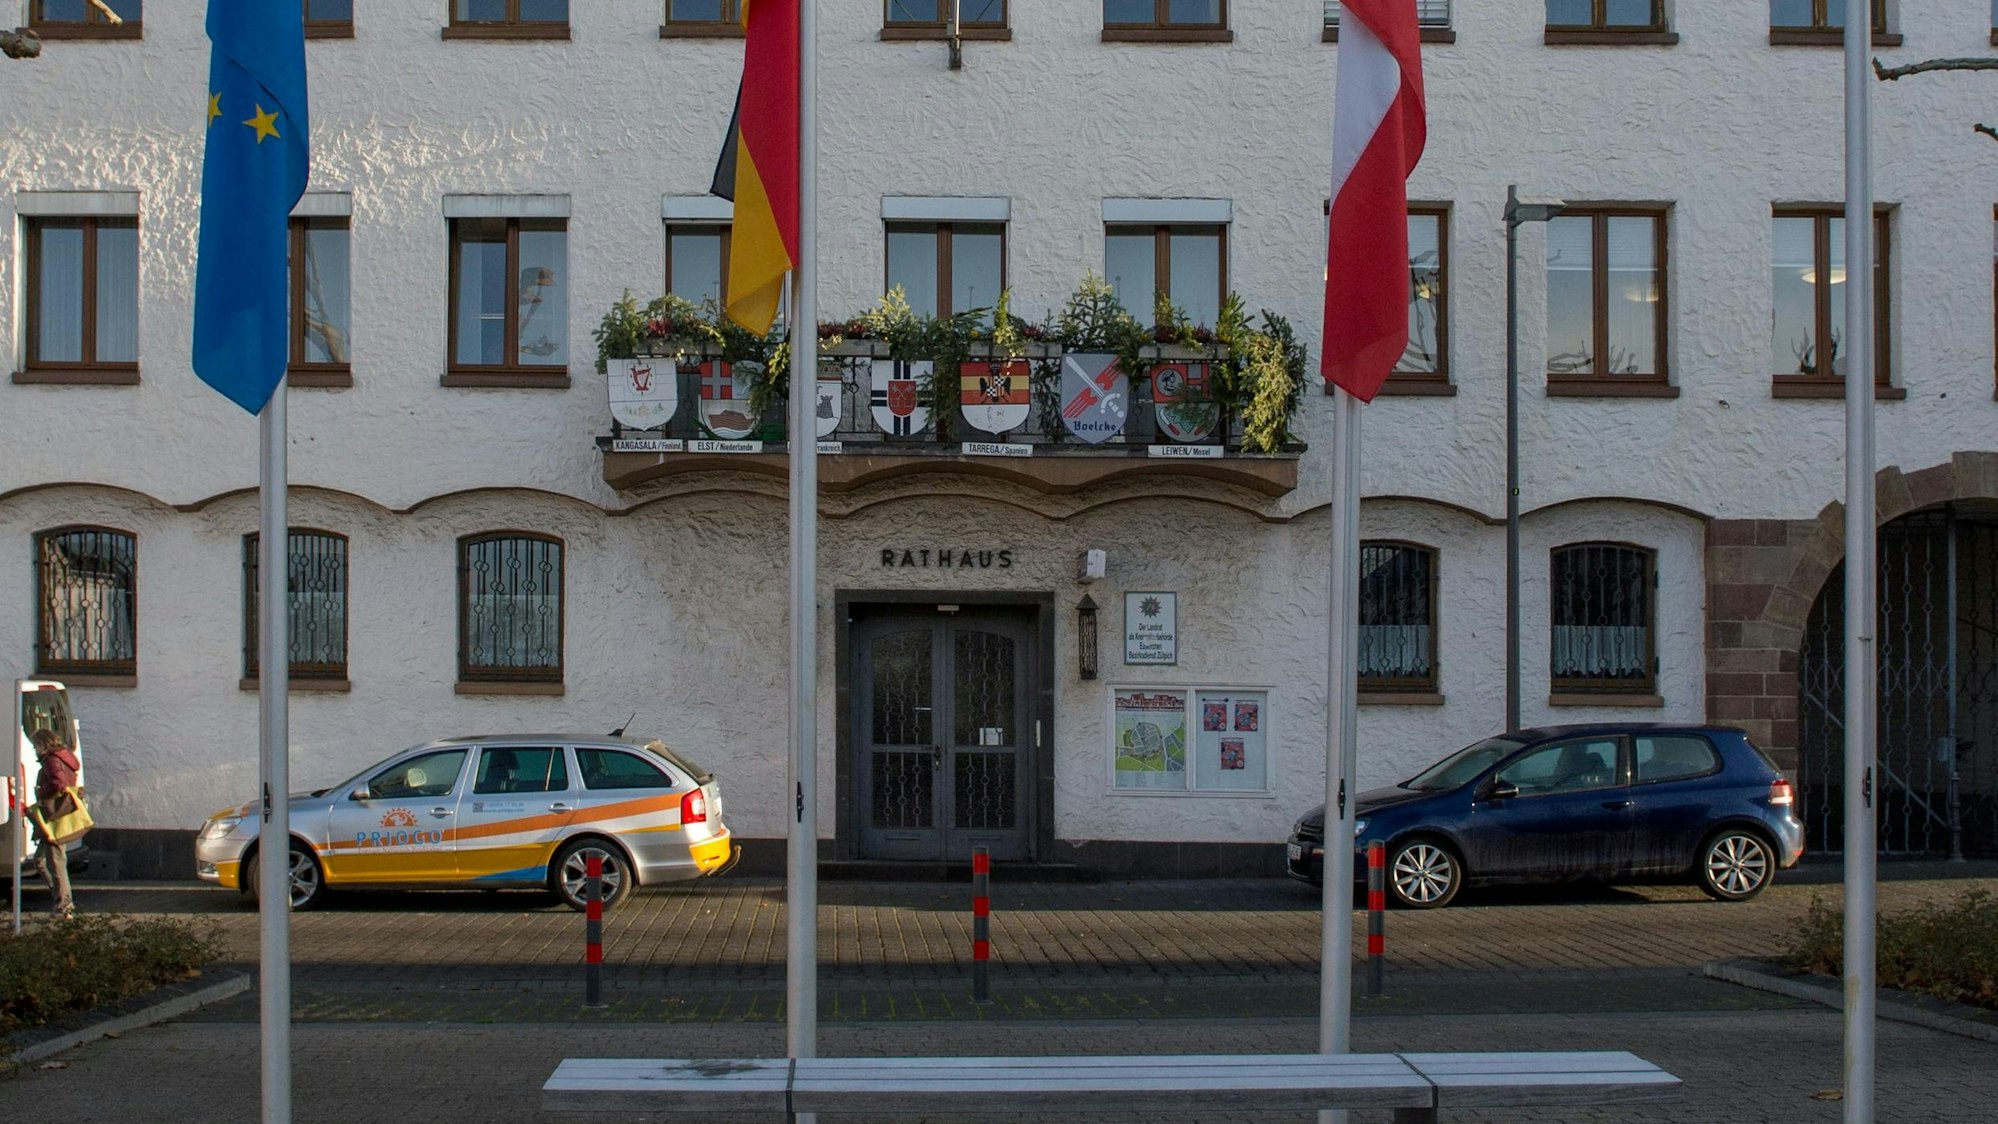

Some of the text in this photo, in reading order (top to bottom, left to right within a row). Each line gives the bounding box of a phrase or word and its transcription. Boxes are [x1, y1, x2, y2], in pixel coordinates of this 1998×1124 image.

[1074, 420, 1116, 431] Boelcke
[881, 549, 1012, 568] RATHAUS
[1138, 623, 1146, 631] Der
